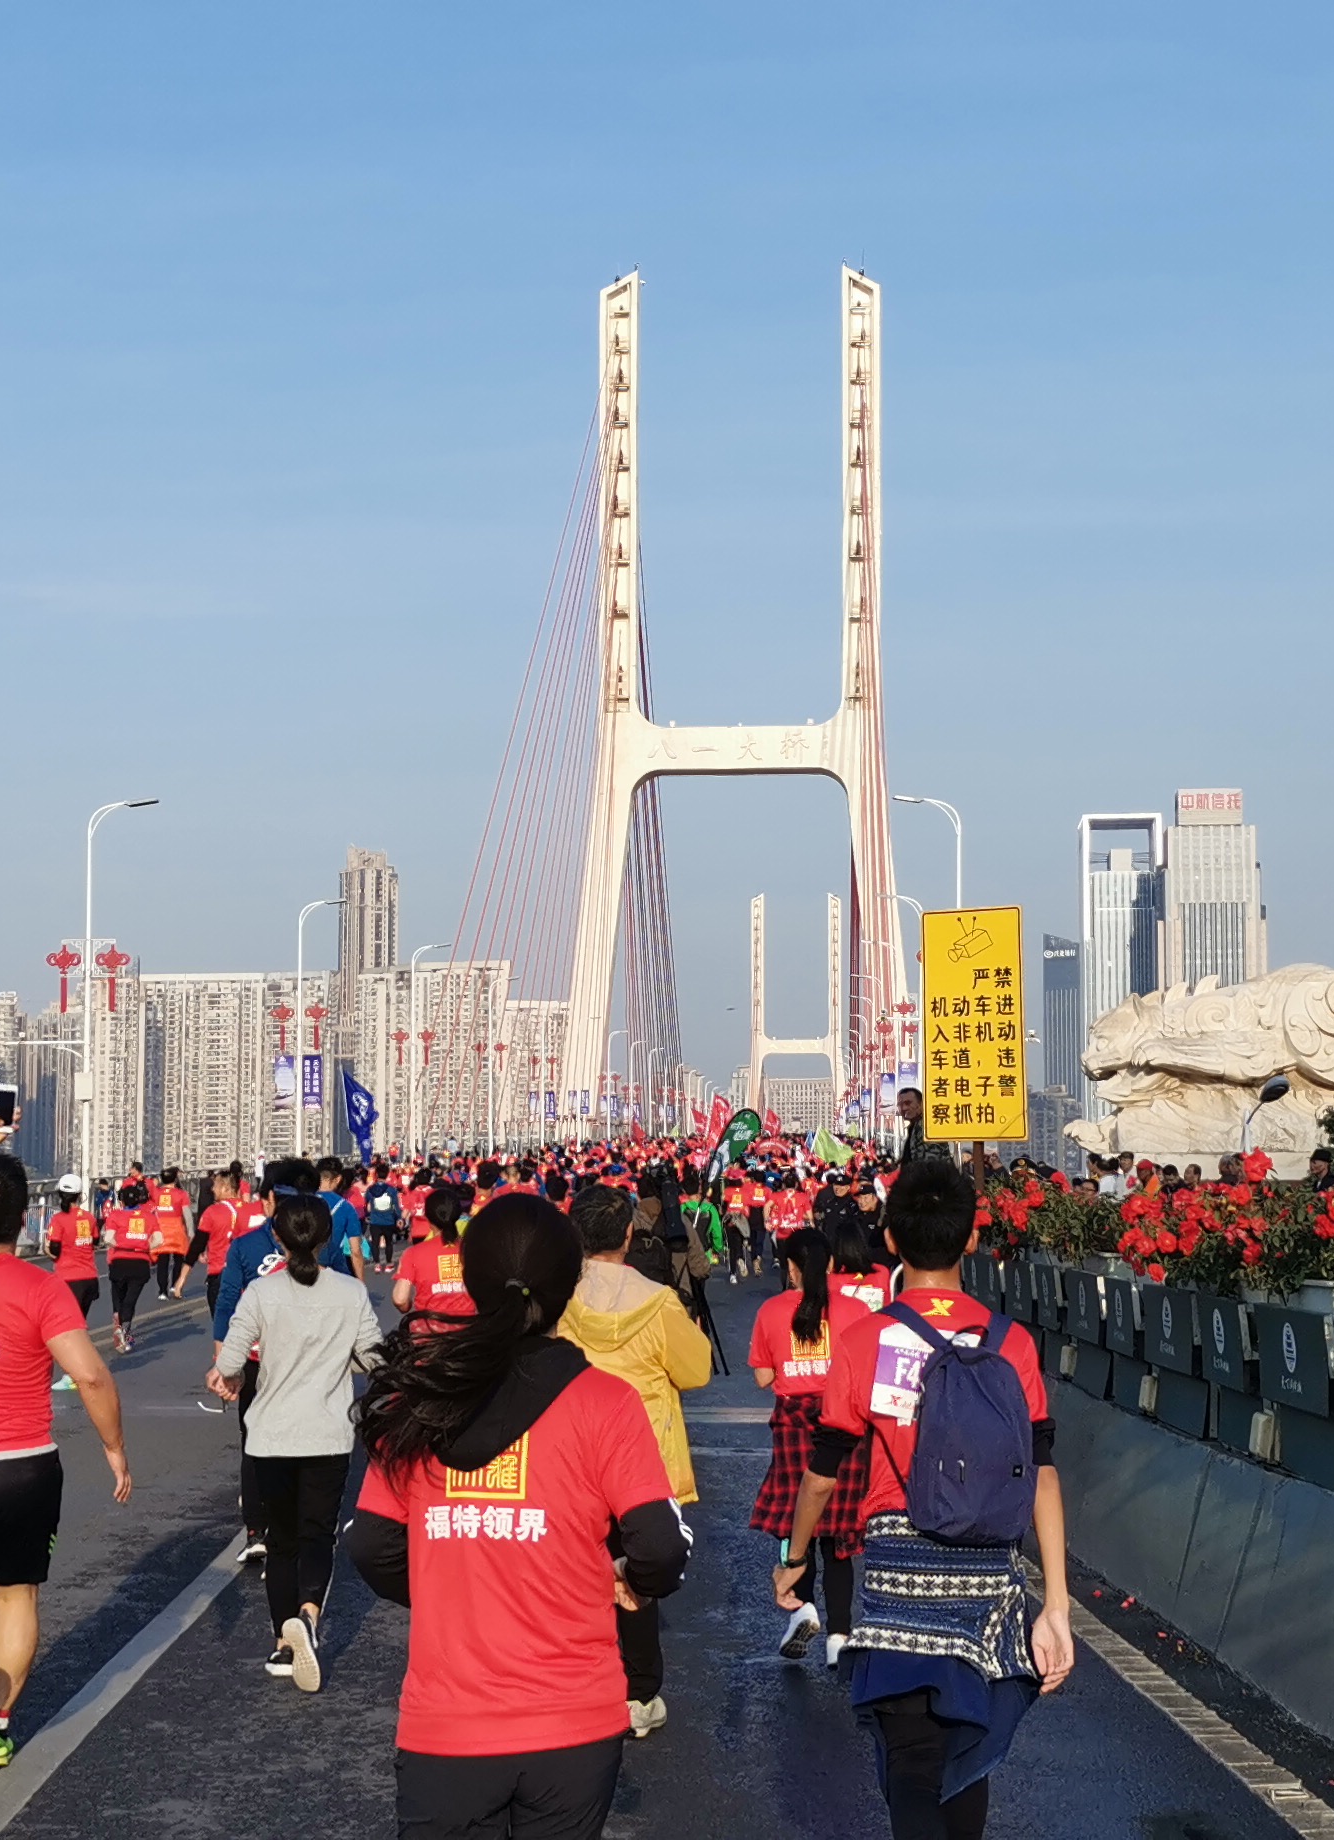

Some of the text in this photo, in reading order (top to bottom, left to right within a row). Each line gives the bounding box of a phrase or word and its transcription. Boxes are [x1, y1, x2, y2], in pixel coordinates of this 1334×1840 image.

[1180, 793, 1243, 811] 中航信托
[972, 966, 1013, 989] 严禁
[931, 994, 1015, 1018] 机动车进
[932, 1020, 1016, 1043] 入非机动
[931, 1048, 1016, 1070] 车道，违
[931, 1074, 1017, 1097] 者电子警
[932, 1102, 1007, 1125] 察抓拍。
[894, 1356, 926, 1392] F4
[424, 1504, 547, 1542] 福特领界
